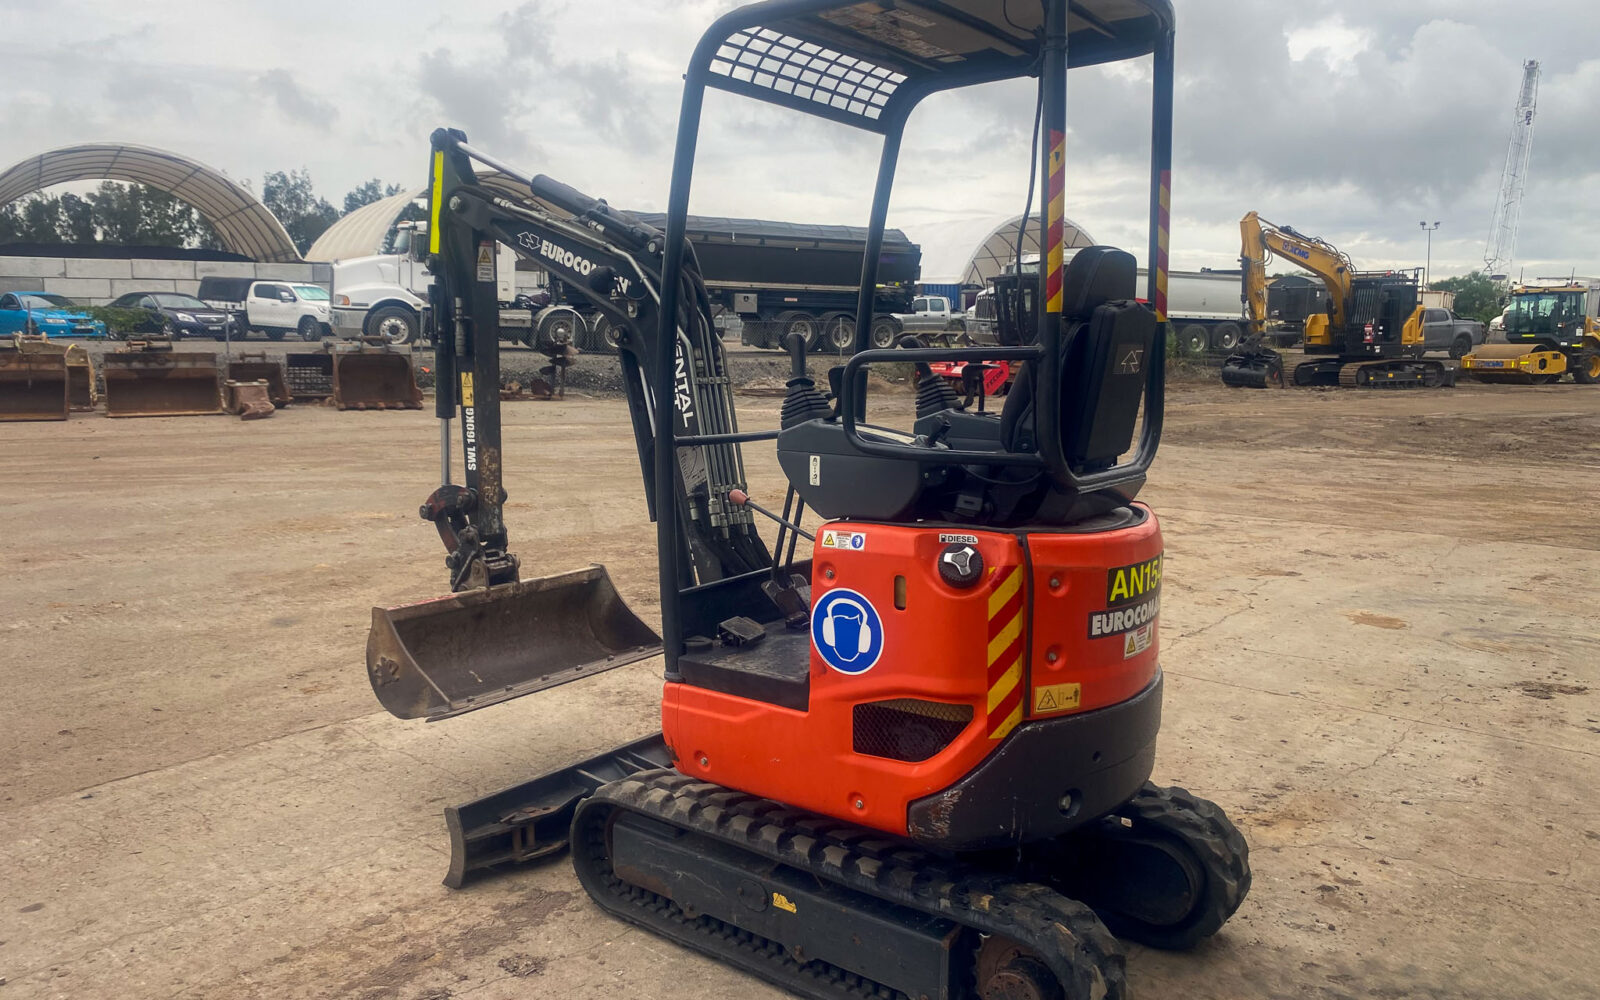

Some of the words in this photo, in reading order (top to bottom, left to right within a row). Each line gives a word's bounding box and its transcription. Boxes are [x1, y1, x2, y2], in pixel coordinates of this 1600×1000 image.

[465, 407, 476, 444] 160KG
[467, 445, 477, 471] SWL
[947, 535, 977, 543] DIESEL
